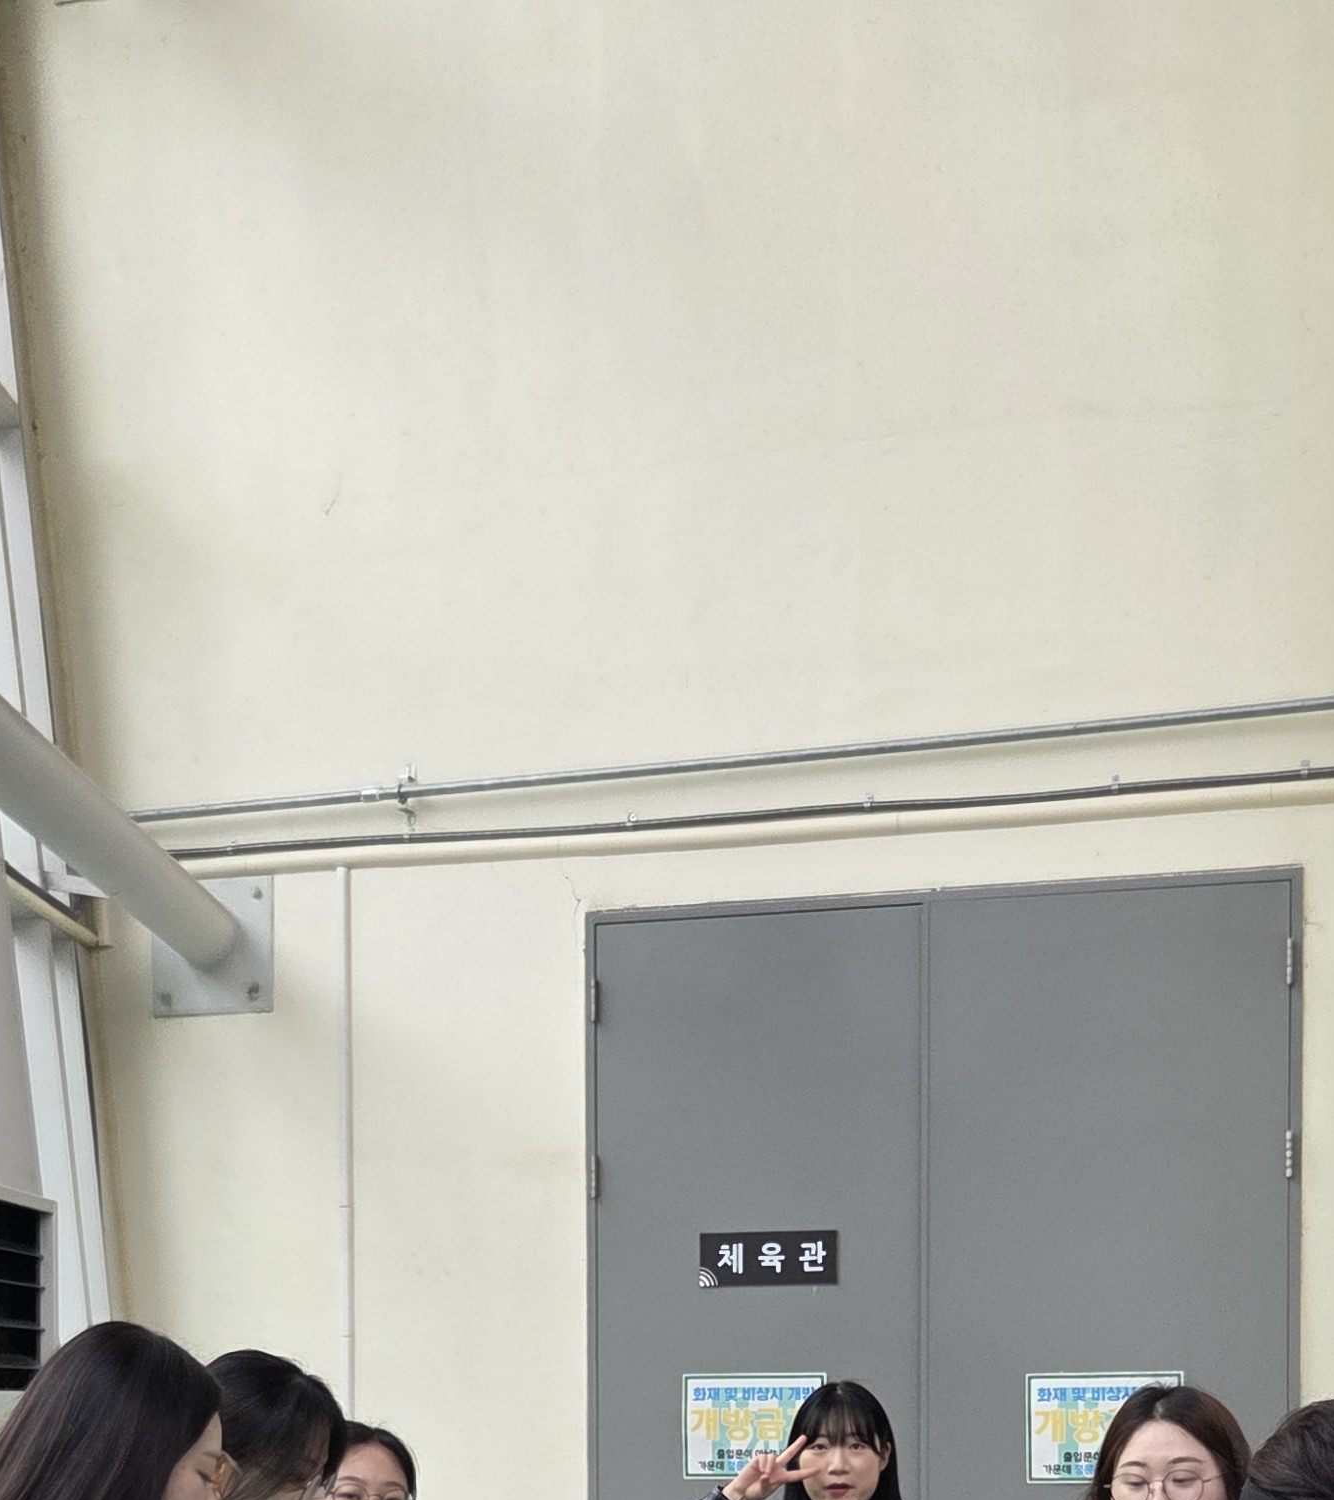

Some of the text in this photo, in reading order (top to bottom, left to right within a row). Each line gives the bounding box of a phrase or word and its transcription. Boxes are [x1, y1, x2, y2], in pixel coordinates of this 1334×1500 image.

[693, 1387, 720, 1402] 화재
[724, 1387, 739, 1402] 및
[742, 1387, 784, 1402] 비상시
[1037, 1387, 1066, 1402] 화재
[1072, 1387, 1087, 1402] 및
[1034, 1409, 1117, 1444] 개방
